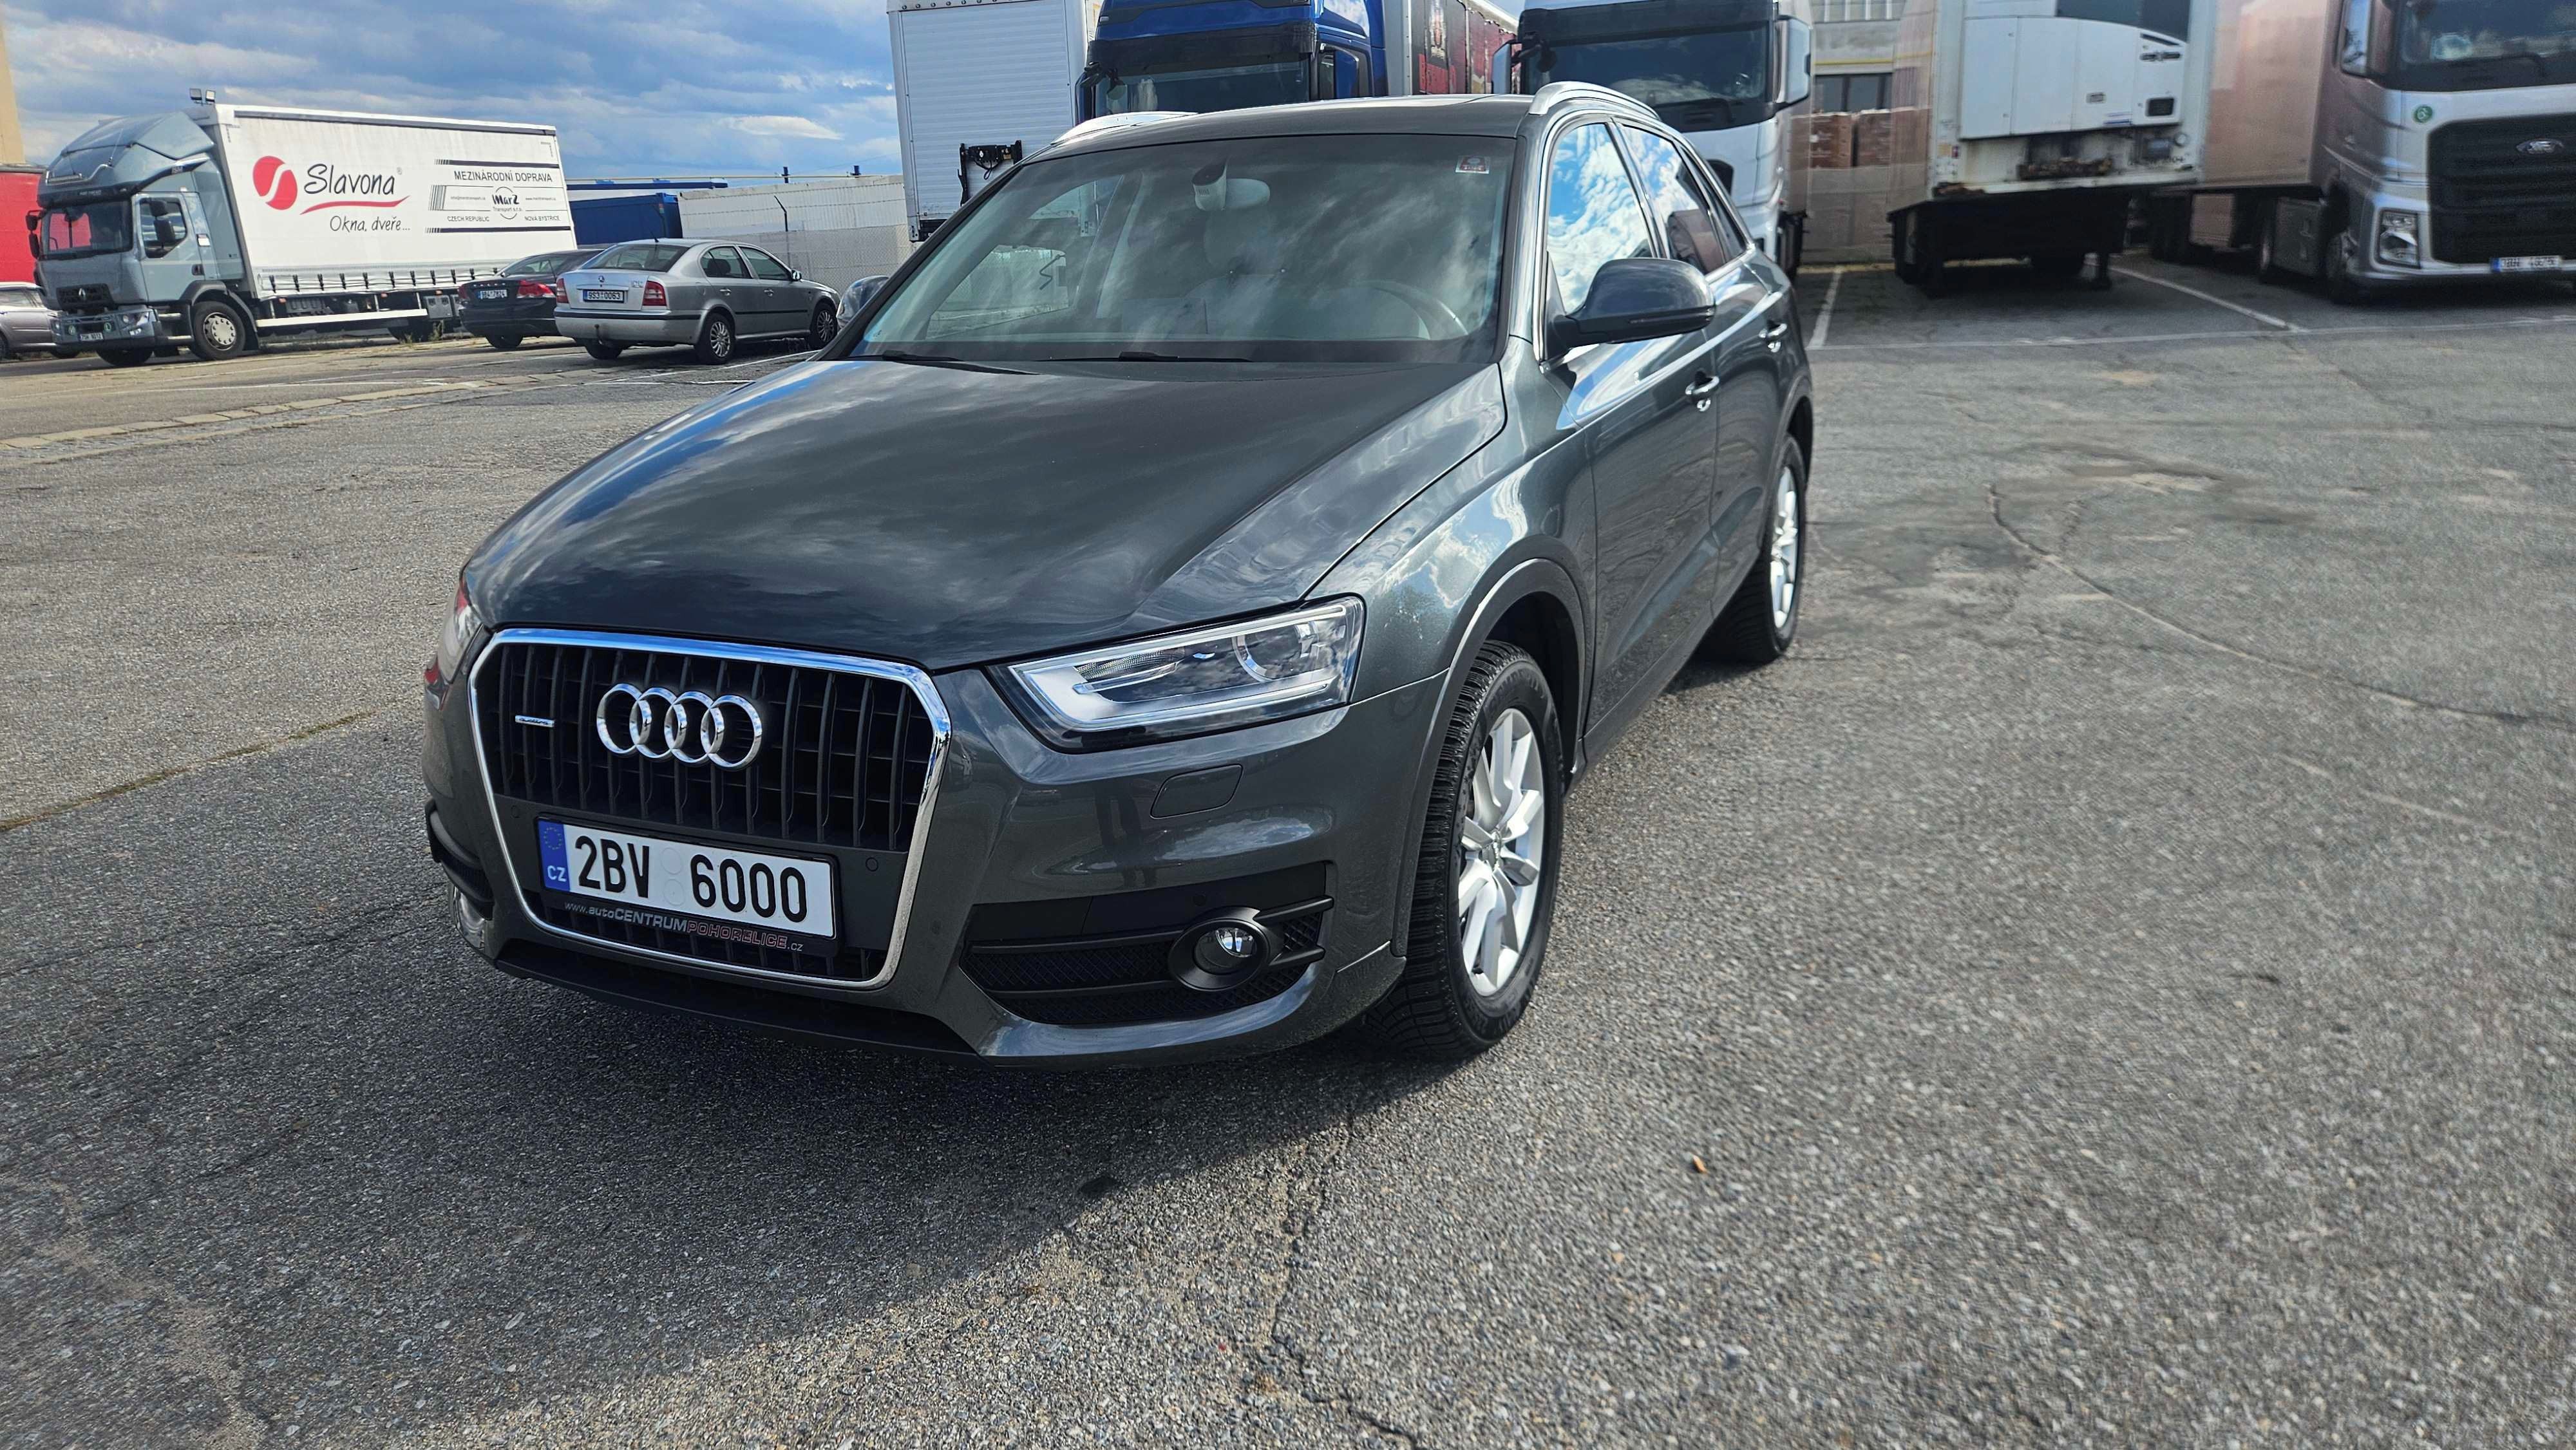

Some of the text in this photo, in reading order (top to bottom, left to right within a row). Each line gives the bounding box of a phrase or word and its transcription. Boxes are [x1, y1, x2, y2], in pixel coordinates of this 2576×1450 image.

[304, 164, 395, 194] Slavona
[454, 169, 553, 182] MEZINÁRODNÍ DOPRAVA
[588, 291, 621, 300] 9S3 0063
[547, 865, 567, 882] CZ
[574, 835, 808, 923] 2BV 6000
